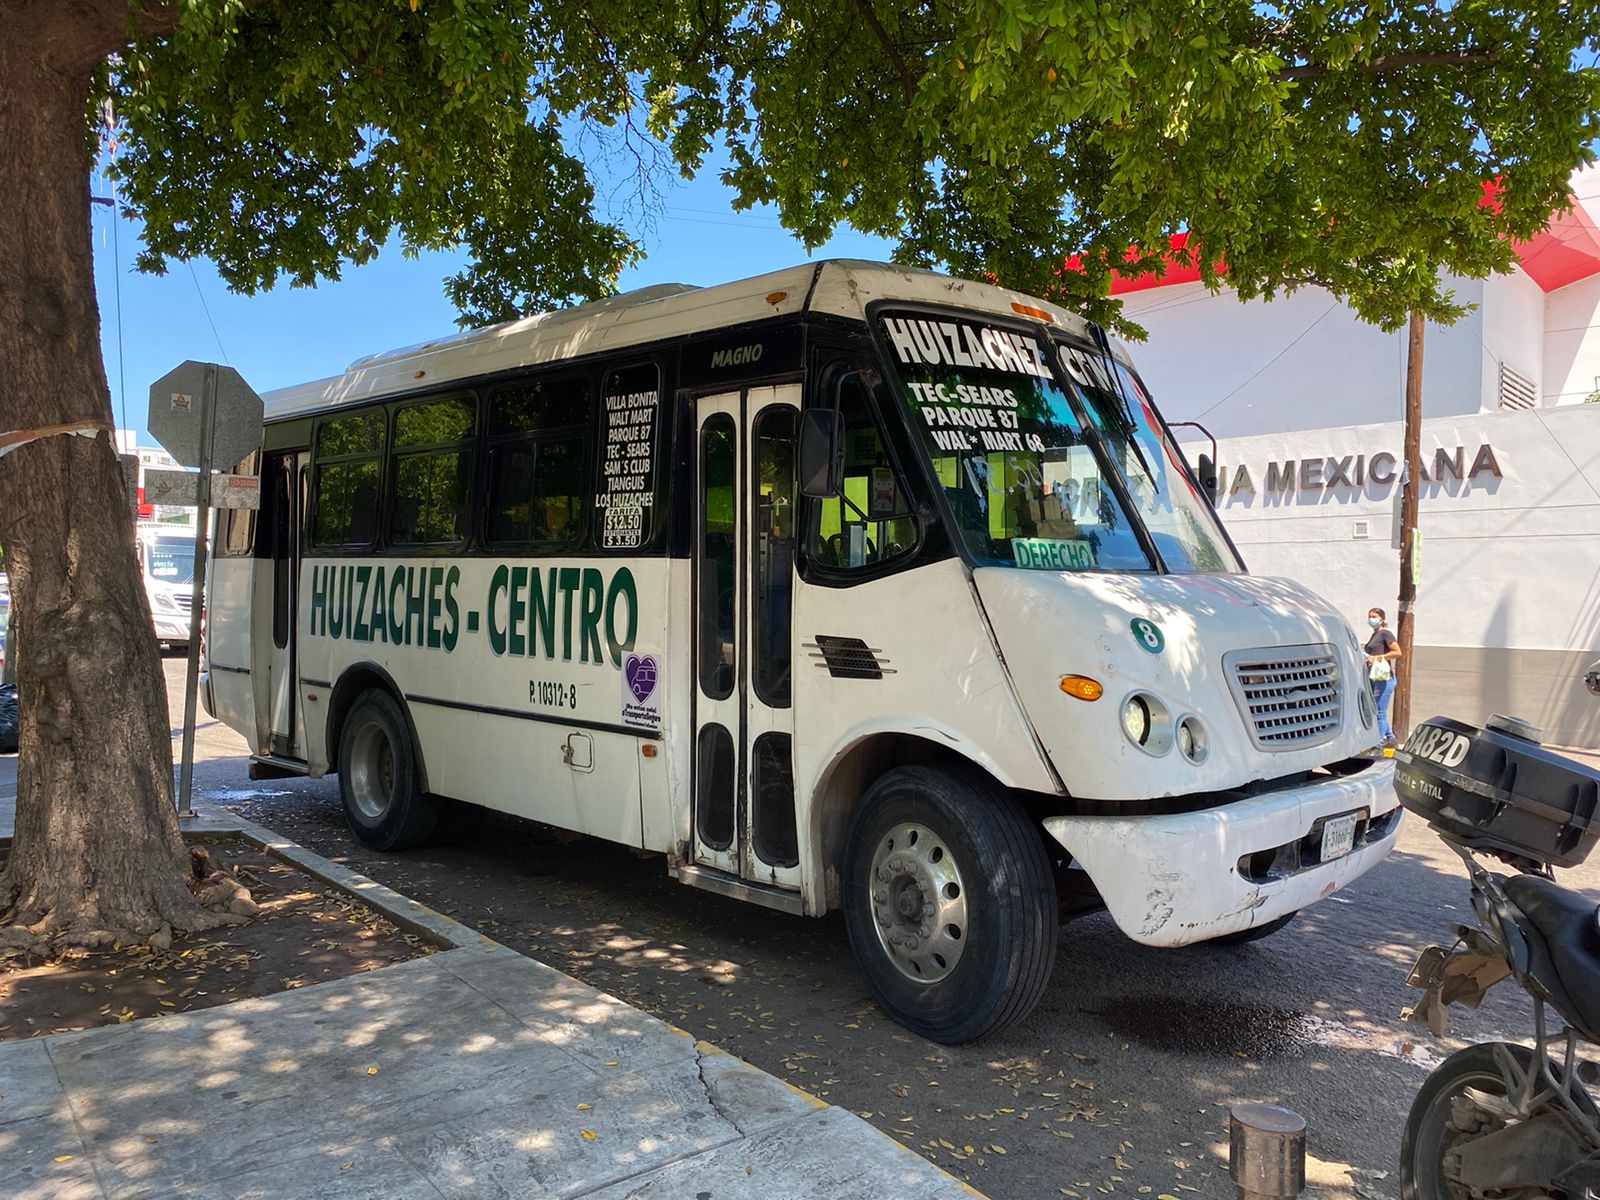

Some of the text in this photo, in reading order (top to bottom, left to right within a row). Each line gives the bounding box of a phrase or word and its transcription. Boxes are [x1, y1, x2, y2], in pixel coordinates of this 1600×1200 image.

[711, 343, 763, 369] MAGNO
[884, 317, 1054, 380] HUIZACHEZ
[605, 390, 658, 410] VILLA BONITA
[907, 382, 1019, 408] TEC-SEARS
[608, 407, 653, 426] WALT MART
[921, 406, 1020, 429] PARQUE 87
[608, 425, 652, 443] PARQUE 87
[980, 431, 1025, 451] MART
[1025, 433, 1046, 453] 68
[606, 444, 620, 459] TEC
[626, 442, 651, 458] SEARS
[630, 458, 651, 474] CLUB
[607, 475, 645, 491] TIANGUIS
[1212, 463, 1256, 497] JA
[595, 492, 654, 508] LOS HUZACHES
[608, 507, 640, 515] TARIFA
[615, 535, 637, 546] 3.50
[1016, 541, 1092, 569] DERECHO
[310, 565, 461, 652] HUIZACHES
[487, 564, 638, 671] CENTRO
[1138, 622, 1159, 648] 8
[529, 680, 536, 704] P.
